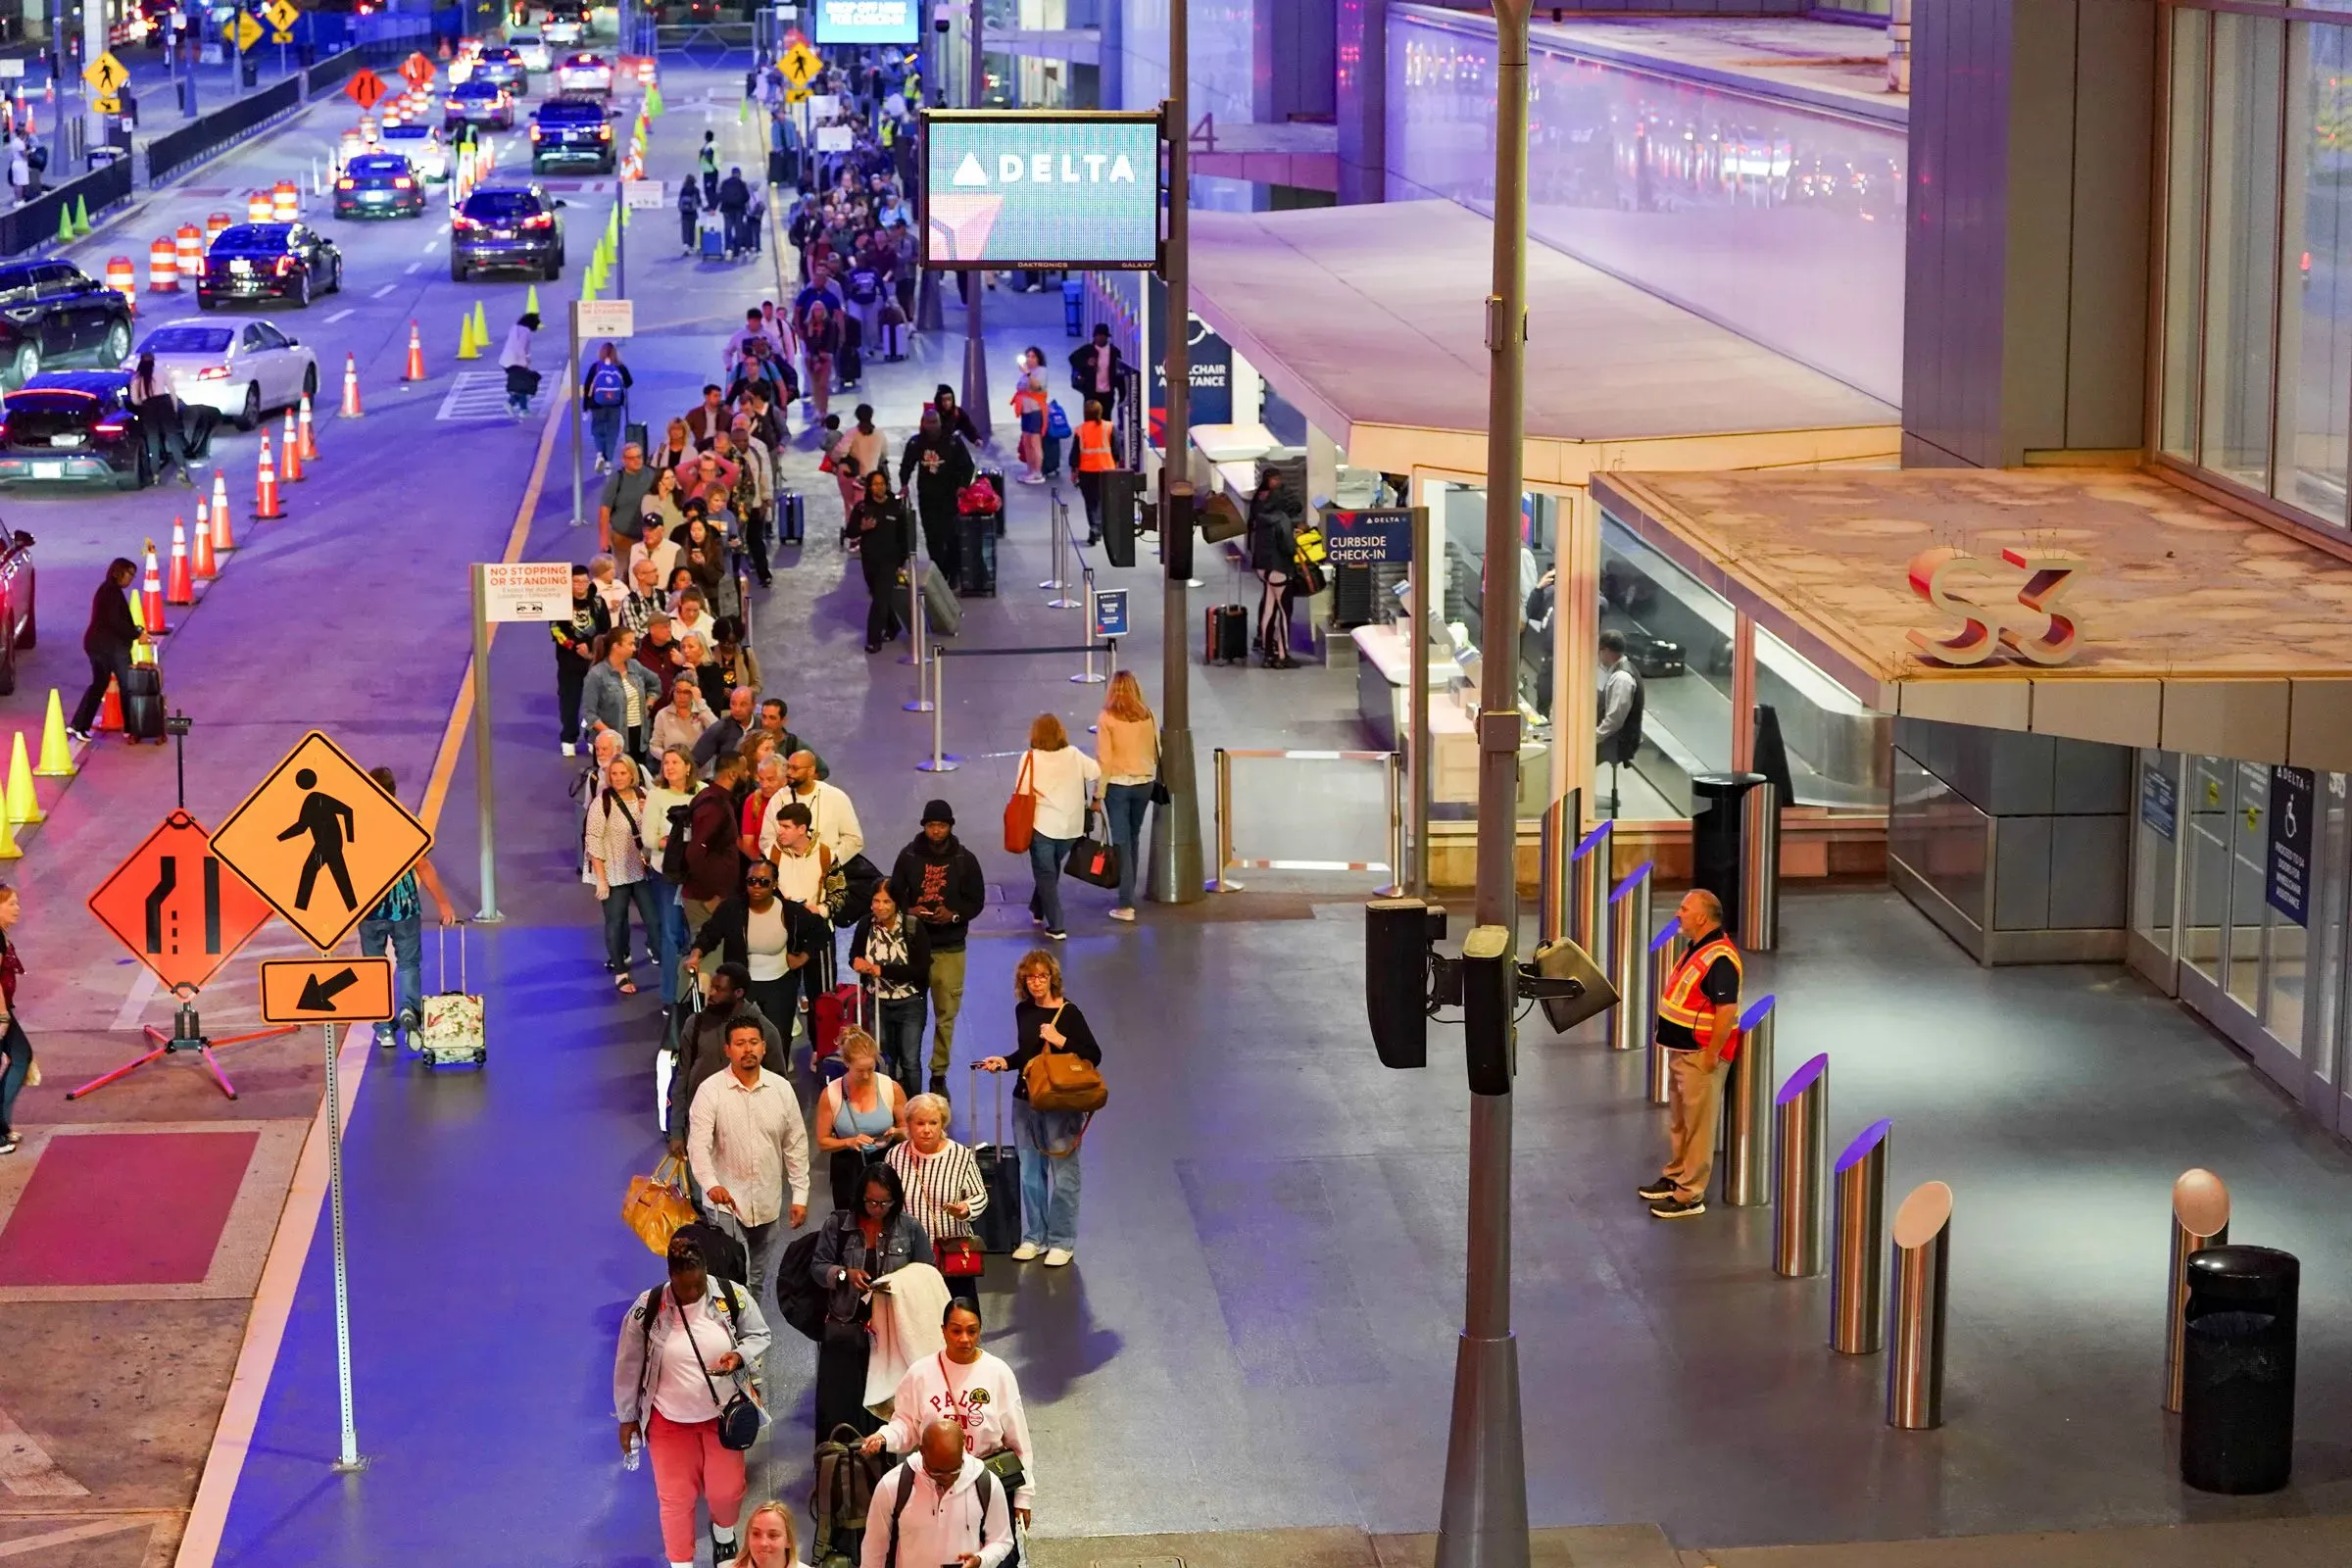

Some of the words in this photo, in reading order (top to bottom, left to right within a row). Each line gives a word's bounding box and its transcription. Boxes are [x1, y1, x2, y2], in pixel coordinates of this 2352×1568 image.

[998, 153, 1137, 184] DELTA
[1154, 365, 1226, 375] WCHAIR
[1158, 376, 1225, 387] ATANCE
[1330, 536, 1387, 547] CURBSIDE
[1330, 550, 1386, 561] CHECK-IN
[511, 566, 566, 575] STOPPING
[1906, 547, 2086, 665] S3
[2283, 768, 2304, 790] DELTA
